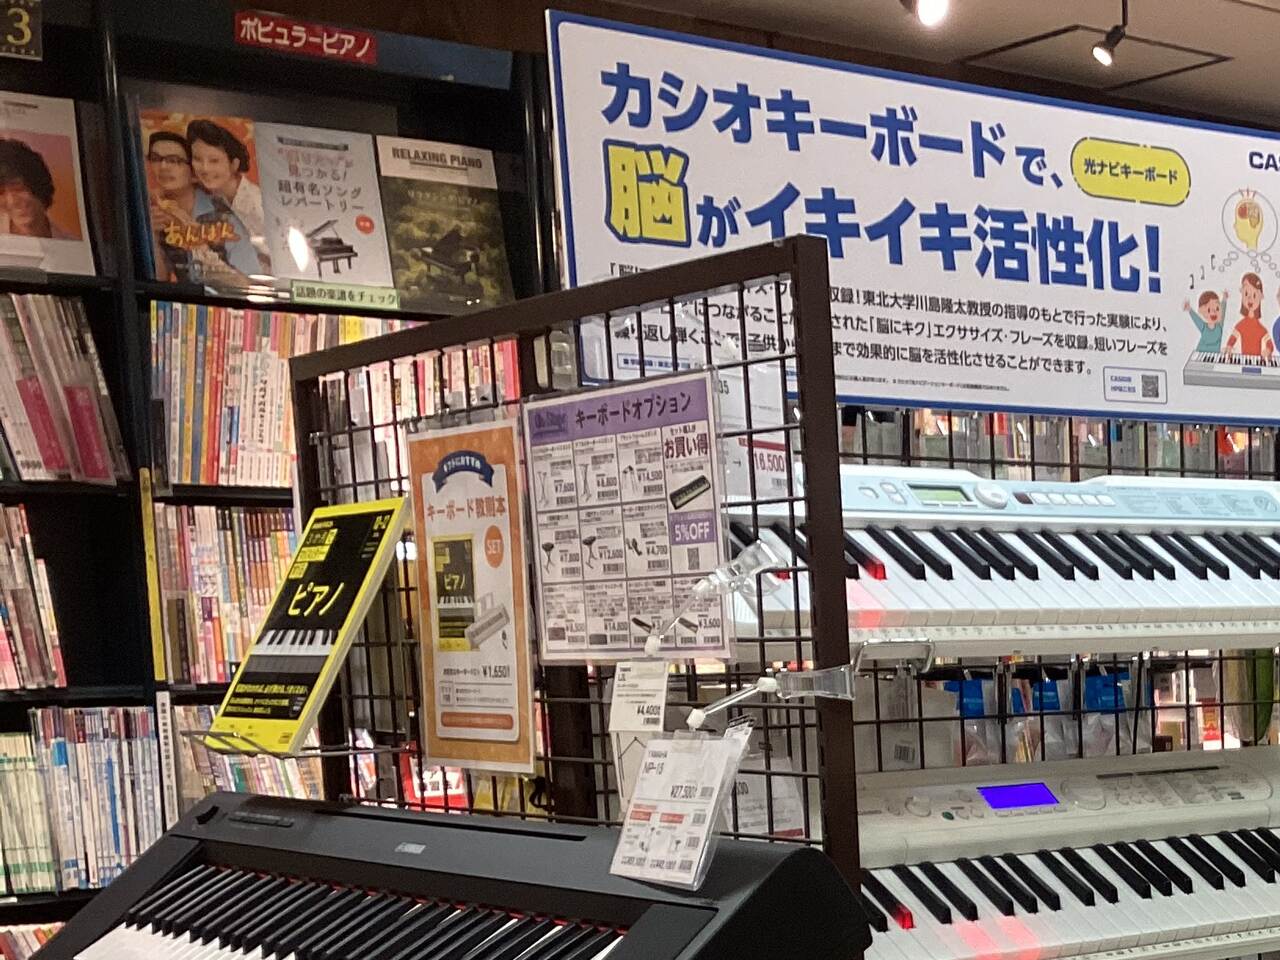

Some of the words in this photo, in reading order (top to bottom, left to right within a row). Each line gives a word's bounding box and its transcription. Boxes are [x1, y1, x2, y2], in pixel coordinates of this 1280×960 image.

[6, 7, 32, 46] 3
[240, 17, 371, 57] ポピュラーピアノ
[600, 61, 1063, 189] カシオキーボードで、
[392, 147, 447, 166] RELAXING
[450, 156, 482, 169] PIANO
[1083, 157, 1178, 186] 光ナビキーボード
[280, 196, 364, 212] レパートリー
[603, 138, 1162, 294] 脳がイキイキ活性化!
[164, 221, 234, 246] あんぱん
[575, 391, 692, 427] キーボードオプション
[664, 432, 709, 460] お買い得
[674, 521, 710, 542] 5%OFF
[288, 582, 345, 617] ピアノ
